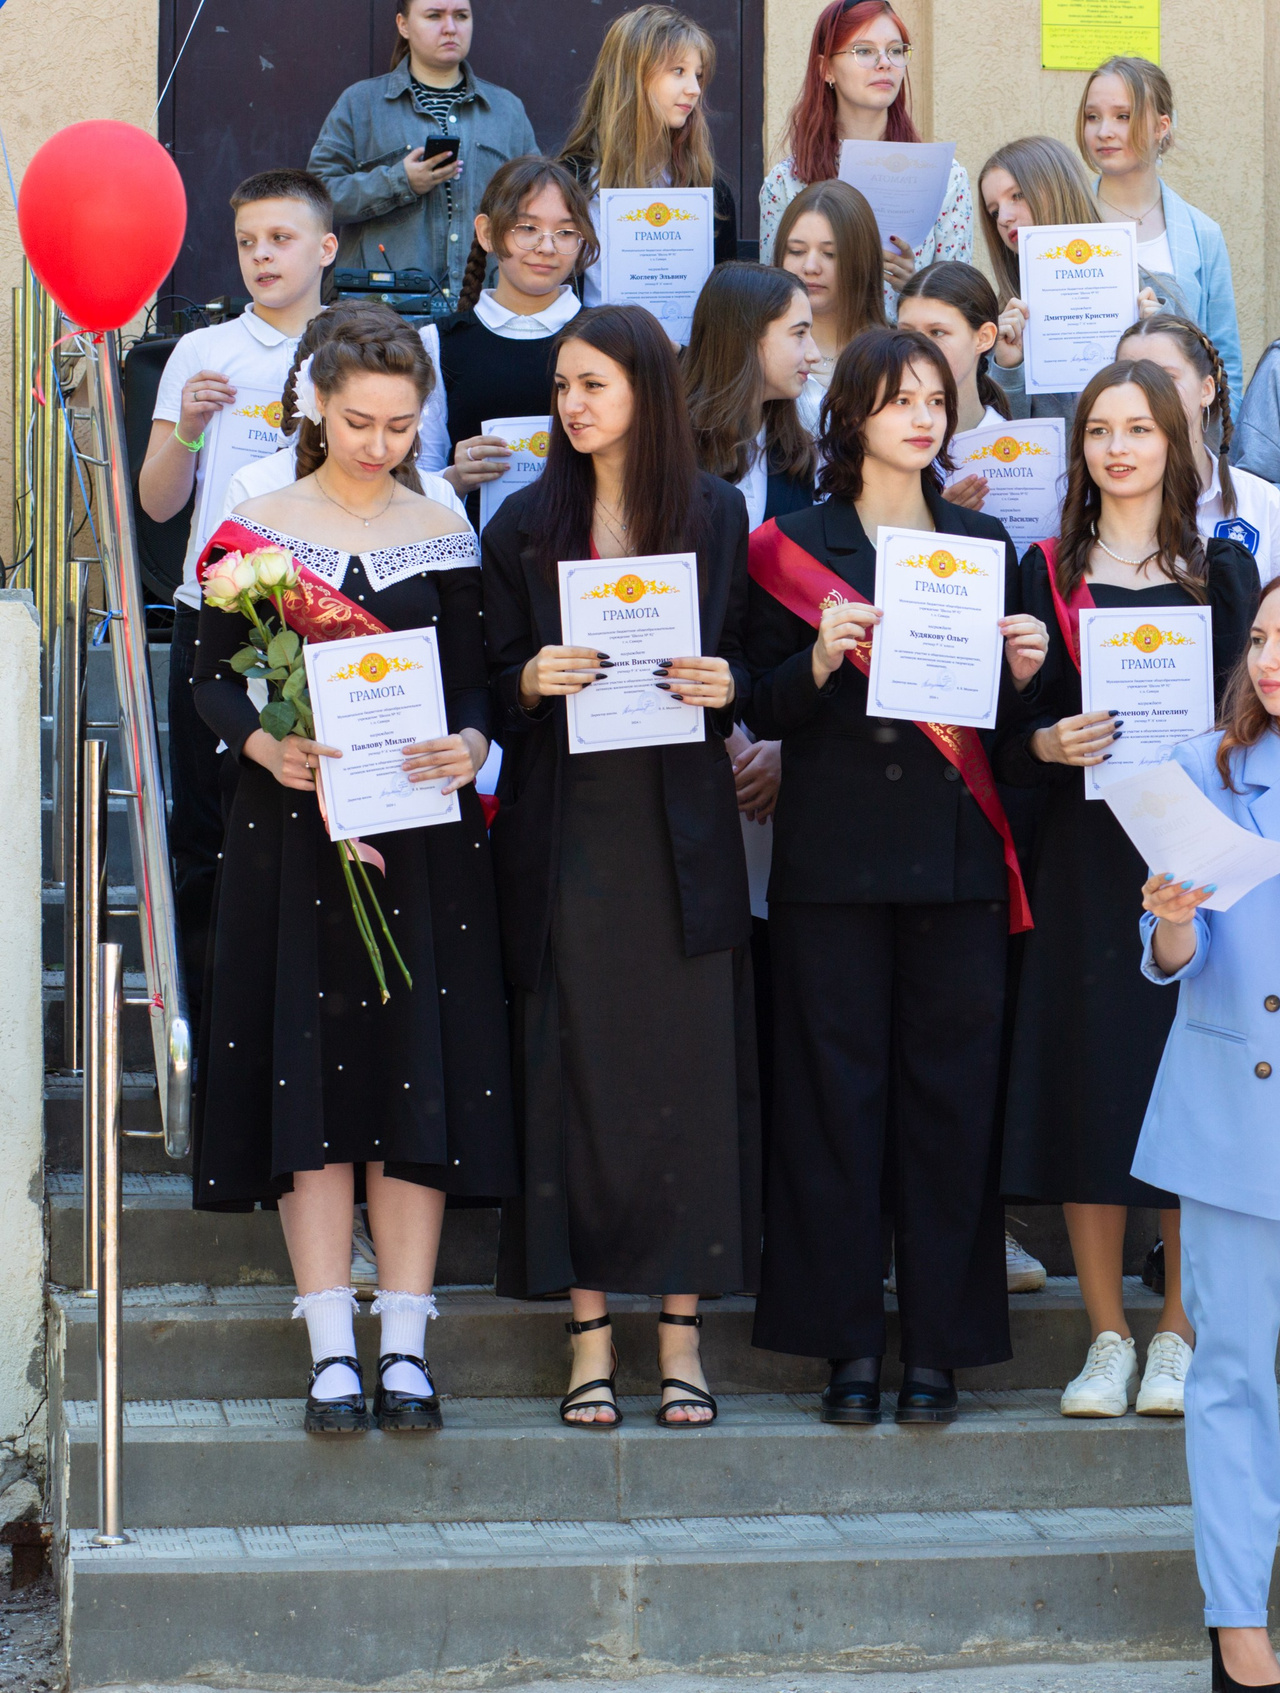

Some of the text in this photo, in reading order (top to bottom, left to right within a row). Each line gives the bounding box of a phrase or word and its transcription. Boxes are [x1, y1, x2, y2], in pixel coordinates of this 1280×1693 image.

[635, 231, 681, 241] ГРАМОТА
[1055, 268, 1104, 279] ГРАМОТА
[248, 429, 278, 443] ГРАМ
[982, 467, 1034, 479] ГРАМОТА
[1009, 515, 1039, 523] Василису
[915, 580, 968, 596] ГРАМОТА
[603, 607, 659, 621] ГРАМОТА
[910, 630, 969, 644] Худякову Ольгу
[632, 658, 675, 667] Виктори
[1121, 658, 1176, 670] ГРАМОТА
[349, 685, 405, 703] ГРАМОТА
[351, 737, 418, 751] Павлову Милану
